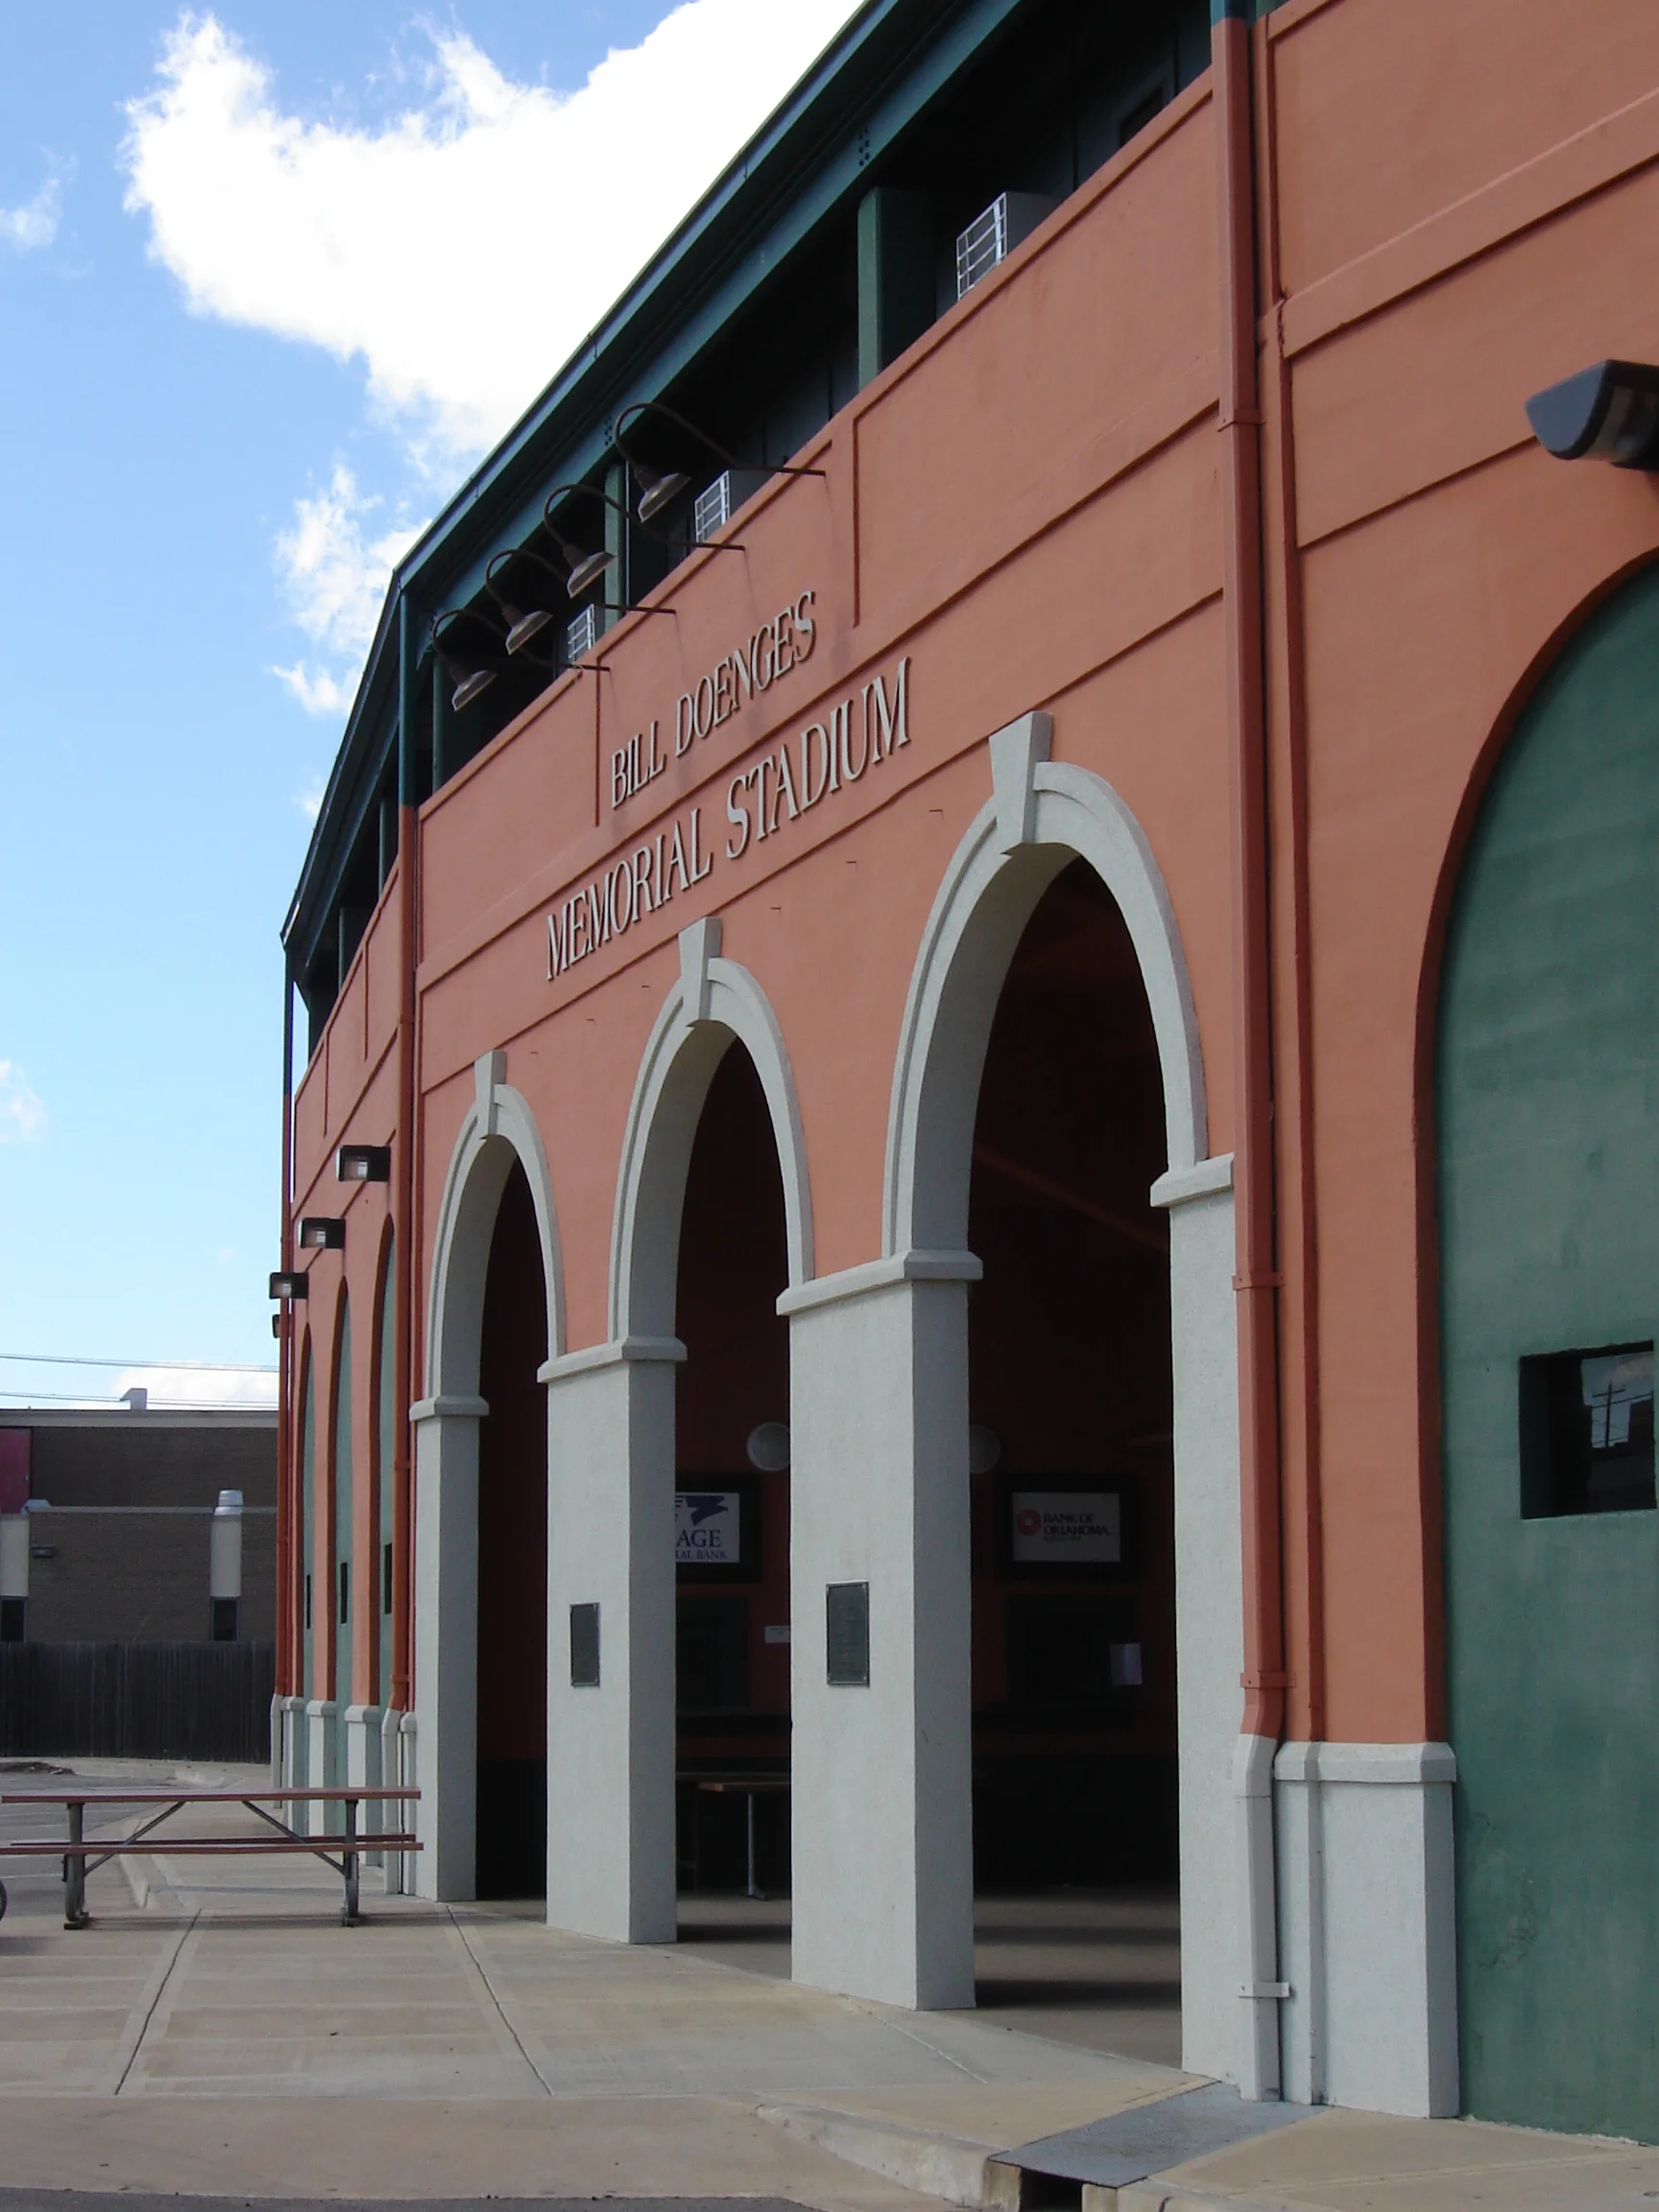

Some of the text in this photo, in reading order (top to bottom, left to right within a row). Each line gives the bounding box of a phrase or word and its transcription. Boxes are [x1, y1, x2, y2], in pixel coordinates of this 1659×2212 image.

[611, 589, 816, 810] BILL DOENGES
[545, 656, 911, 981] MEMORIAL STADIUM
[1044, 1512, 1094, 1524] BANK OF
[1044, 1525, 1109, 1535] OKLAHOMA
[696, 1550, 728, 1559] BANK
